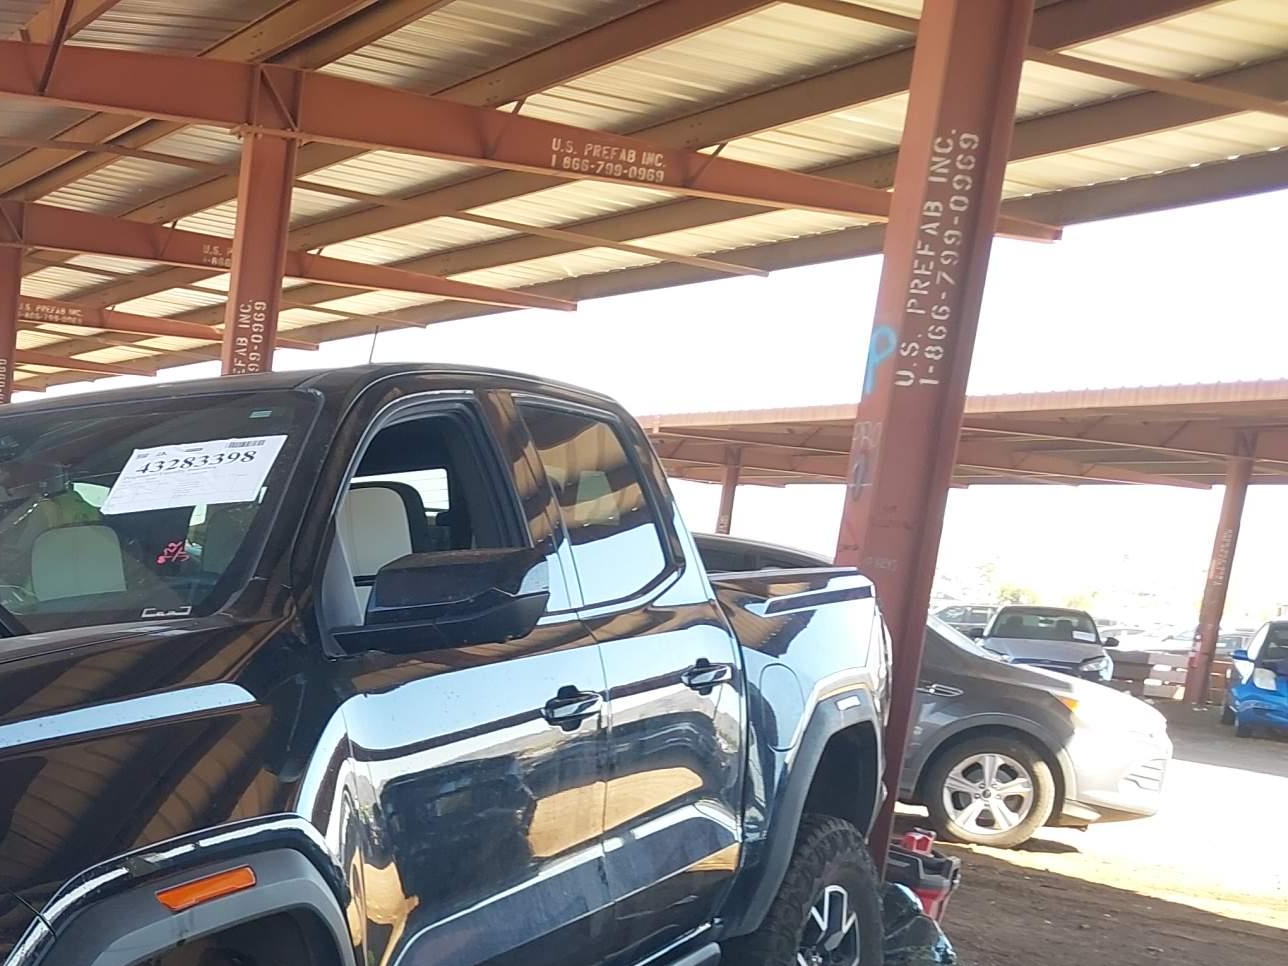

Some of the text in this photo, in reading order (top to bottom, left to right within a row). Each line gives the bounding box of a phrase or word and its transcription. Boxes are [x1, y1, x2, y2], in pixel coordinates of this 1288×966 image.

[551, 137, 667, 168] U.S. PREFAB INC.
[895, 129, 957, 386] U.S. PREFAB INC.
[919, 133, 979, 385] 1-866-799-0969
[239, 299, 253, 328] INC.
[135, 450, 257, 474] 43283398
